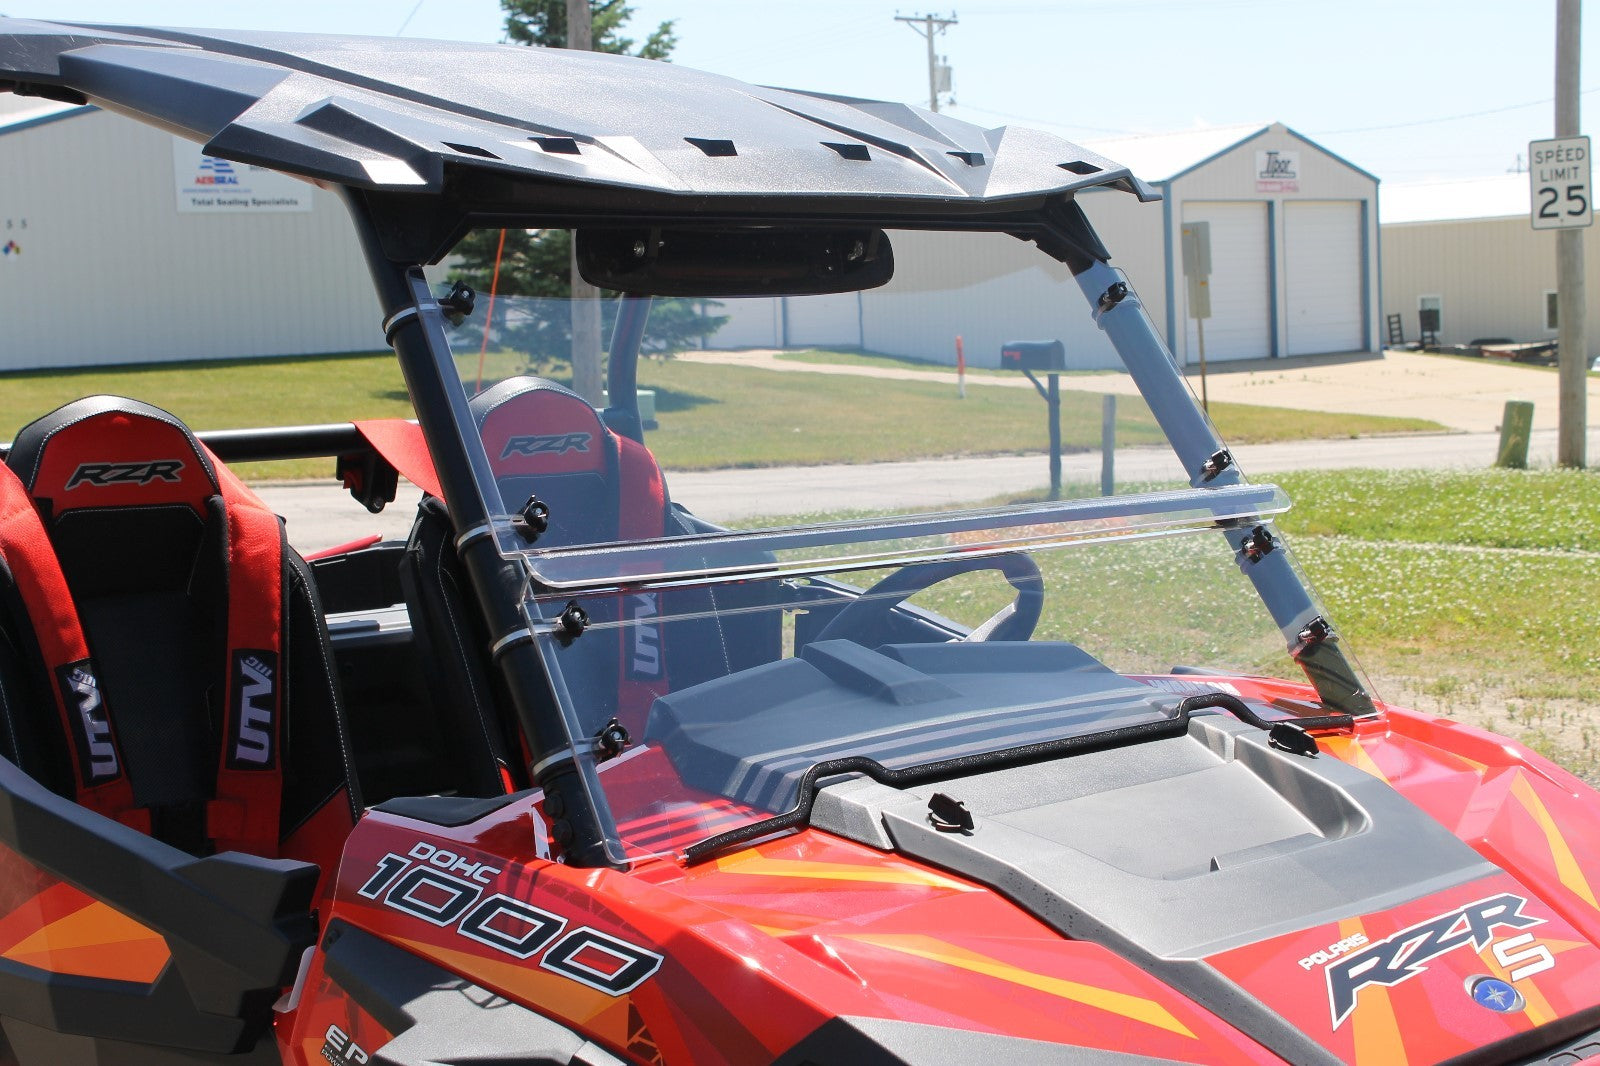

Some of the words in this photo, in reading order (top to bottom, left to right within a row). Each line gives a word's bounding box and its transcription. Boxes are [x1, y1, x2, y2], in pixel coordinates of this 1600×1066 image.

[1535, 147, 1585, 164] SPEED
[1540, 166, 1580, 182] LIMIT
[192, 197, 214, 206] Total
[216, 197, 249, 207] Sealing
[251, 197, 299, 207] Specialists
[1538, 184, 1587, 219] 25
[501, 432, 593, 461] RZR
[64, 460, 186, 491] RZR
[67, 675, 118, 779] UTV
[235, 659, 272, 764] UTV
[408, 841, 500, 884] DOHC
[357, 853, 665, 998] 1000
[1297, 932, 1369, 971] POLARIS
[1324, 892, 1549, 1032] RZR
[1492, 932, 1556, 983] S
